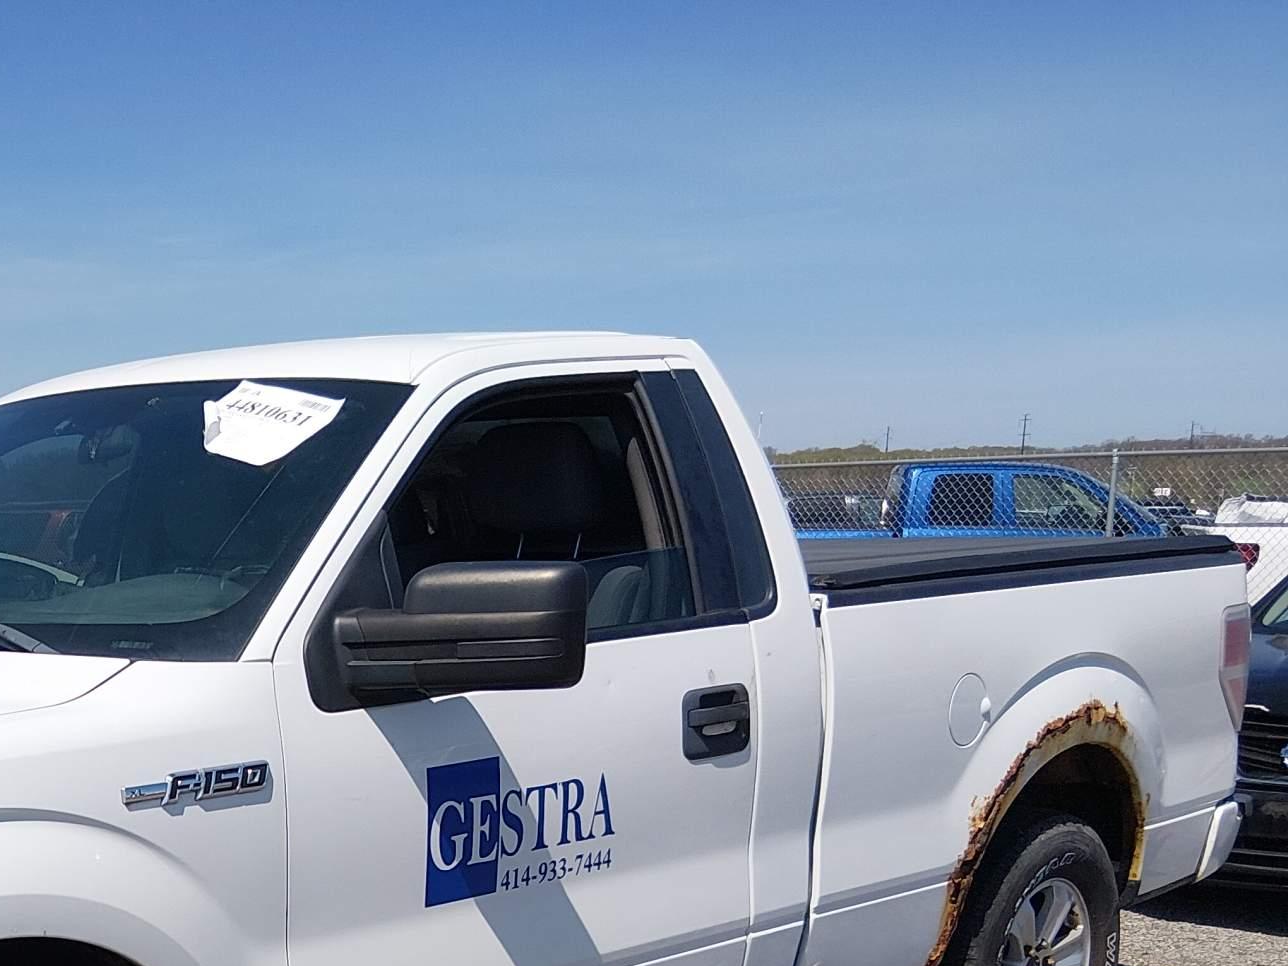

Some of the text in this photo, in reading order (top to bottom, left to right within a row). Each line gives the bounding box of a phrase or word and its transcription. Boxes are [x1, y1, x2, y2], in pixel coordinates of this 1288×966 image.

[226, 399, 312, 426] 44810631
[165, 761, 269, 803] F-150
[430, 773, 615, 871] GESTRA
[501, 848, 612, 891] 414-933-7444
